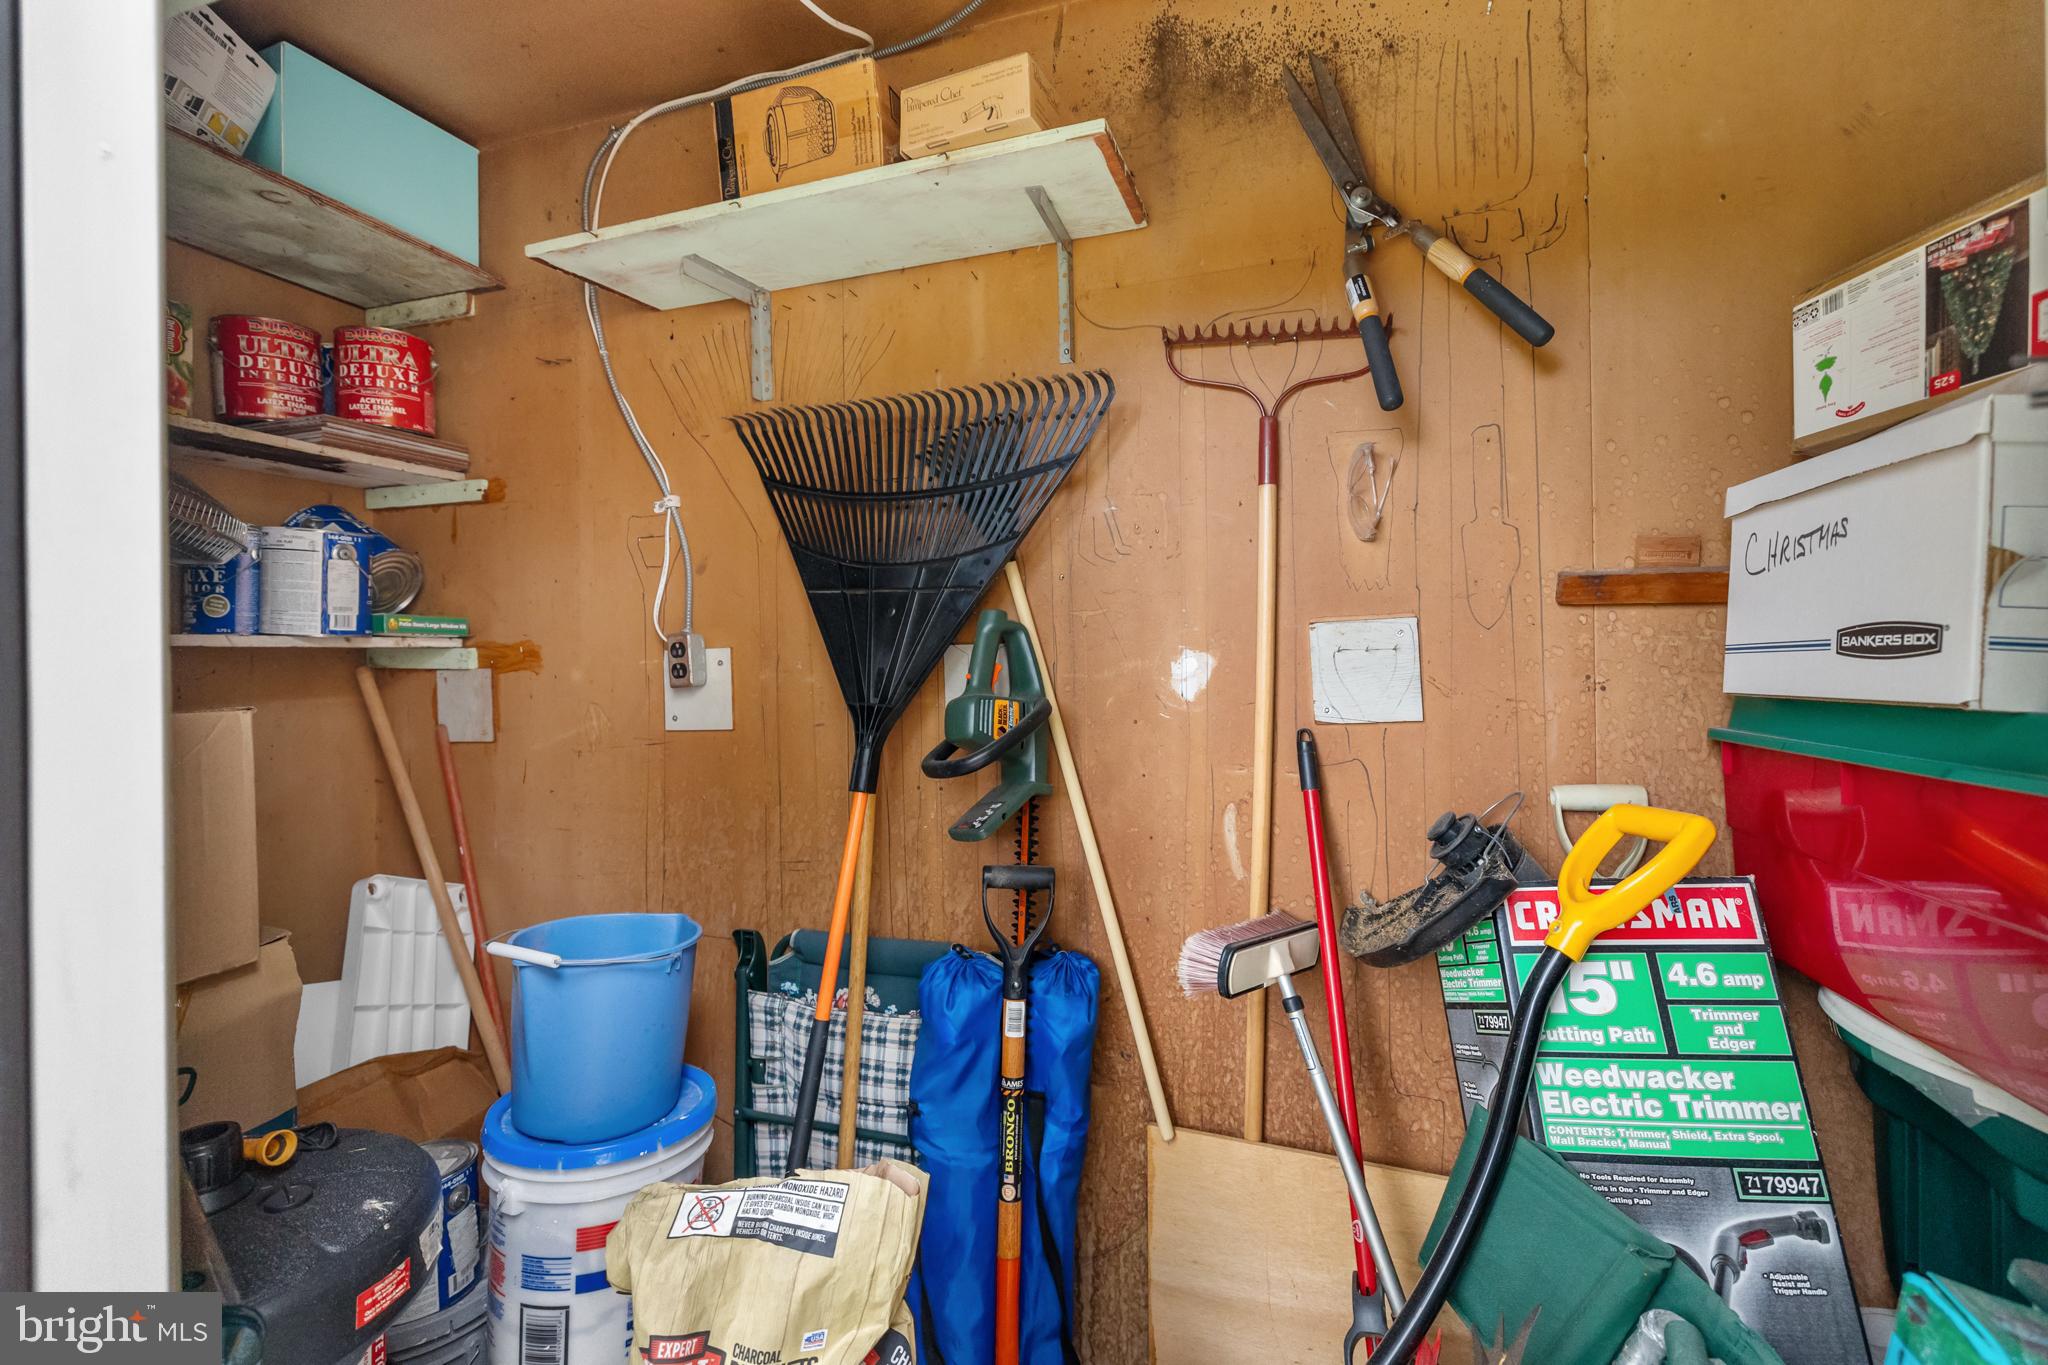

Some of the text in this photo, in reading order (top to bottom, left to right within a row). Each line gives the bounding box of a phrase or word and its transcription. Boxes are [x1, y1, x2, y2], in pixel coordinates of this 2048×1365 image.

[247, 319, 314, 342] DURON
[345, 329, 408, 348] DURON
[237, 334, 319, 365] ULTRA
[339, 344, 419, 371] ULTRA
[239, 355, 320, 380] DELUXE
[339, 363, 419, 384] DELUXE
[339, 377, 419, 394] INTERIOR
[257, 397, 317, 413] LATEX ENAMEL
[349, 403, 407, 415] LATEX ENAMEL
[360, 397, 393, 406] ACRYLIC
[1745, 517, 1849, 576] CHRISTMAS
[1841, 632, 1937, 648] BANKERS BOX
[1440, 967, 1485, 978] Weedwacker
[1668, 962, 1764, 990] 4.6 amp
[1443, 978, 1502, 988] Electric Trimmer
[1690, 1008, 1759, 1021] Trimmer
[1541, 1025, 1656, 1046] utting Path
[1714, 1023, 1744, 1035] and
[1708, 1037, 1756, 1052] Edger
[1536, 1062, 1735, 1090] Weedwacker
[1544, 1090, 1802, 1121] Electric Trimmer
[1005, 1098, 1016, 1173] BRONCO
[1548, 1125, 1784, 1144] CONTENTS: Trimmer, Shield, Extra Spool,
[1550, 1135, 1671, 1149] Wall Bracket, Manual
[1613, 1174, 1646, 1184] Required
[1659, 1177, 1694, 1186] Assembly
[781, 1181, 818, 1194] MONOXIDE
[820, 1185, 845, 1199] HAZARD
[1639, 1187, 1670, 1195] Trimmer
[747, 1193, 768, 1201] BURNING
[768, 1194, 795, 1204] CHARCOAL
[795, 1198, 811, 1207] INSIDE
[811, 1201, 822, 1210] CAN
[749, 1200, 763, 1208] GIVES
[773, 1202, 794, 1213] CARBON
[1634, 1198, 1651, 1206] Path
[736, 1227, 760, 1235] VEHICLES
[760, 1228, 767, 1236] OR
[737, 1220, 755, 1228] NEVER
[768, 1223, 795, 1236] CHARCOAL
[795, 1228, 811, 1240] INSIDE
[1770, 1273, 1809, 1281] Adjustable
[1773, 1287, 1828, 1296] Trigger Handle
[657, 1338, 698, 1359] EXPERT
[733, 1343, 782, 1362] CHARCOAL
